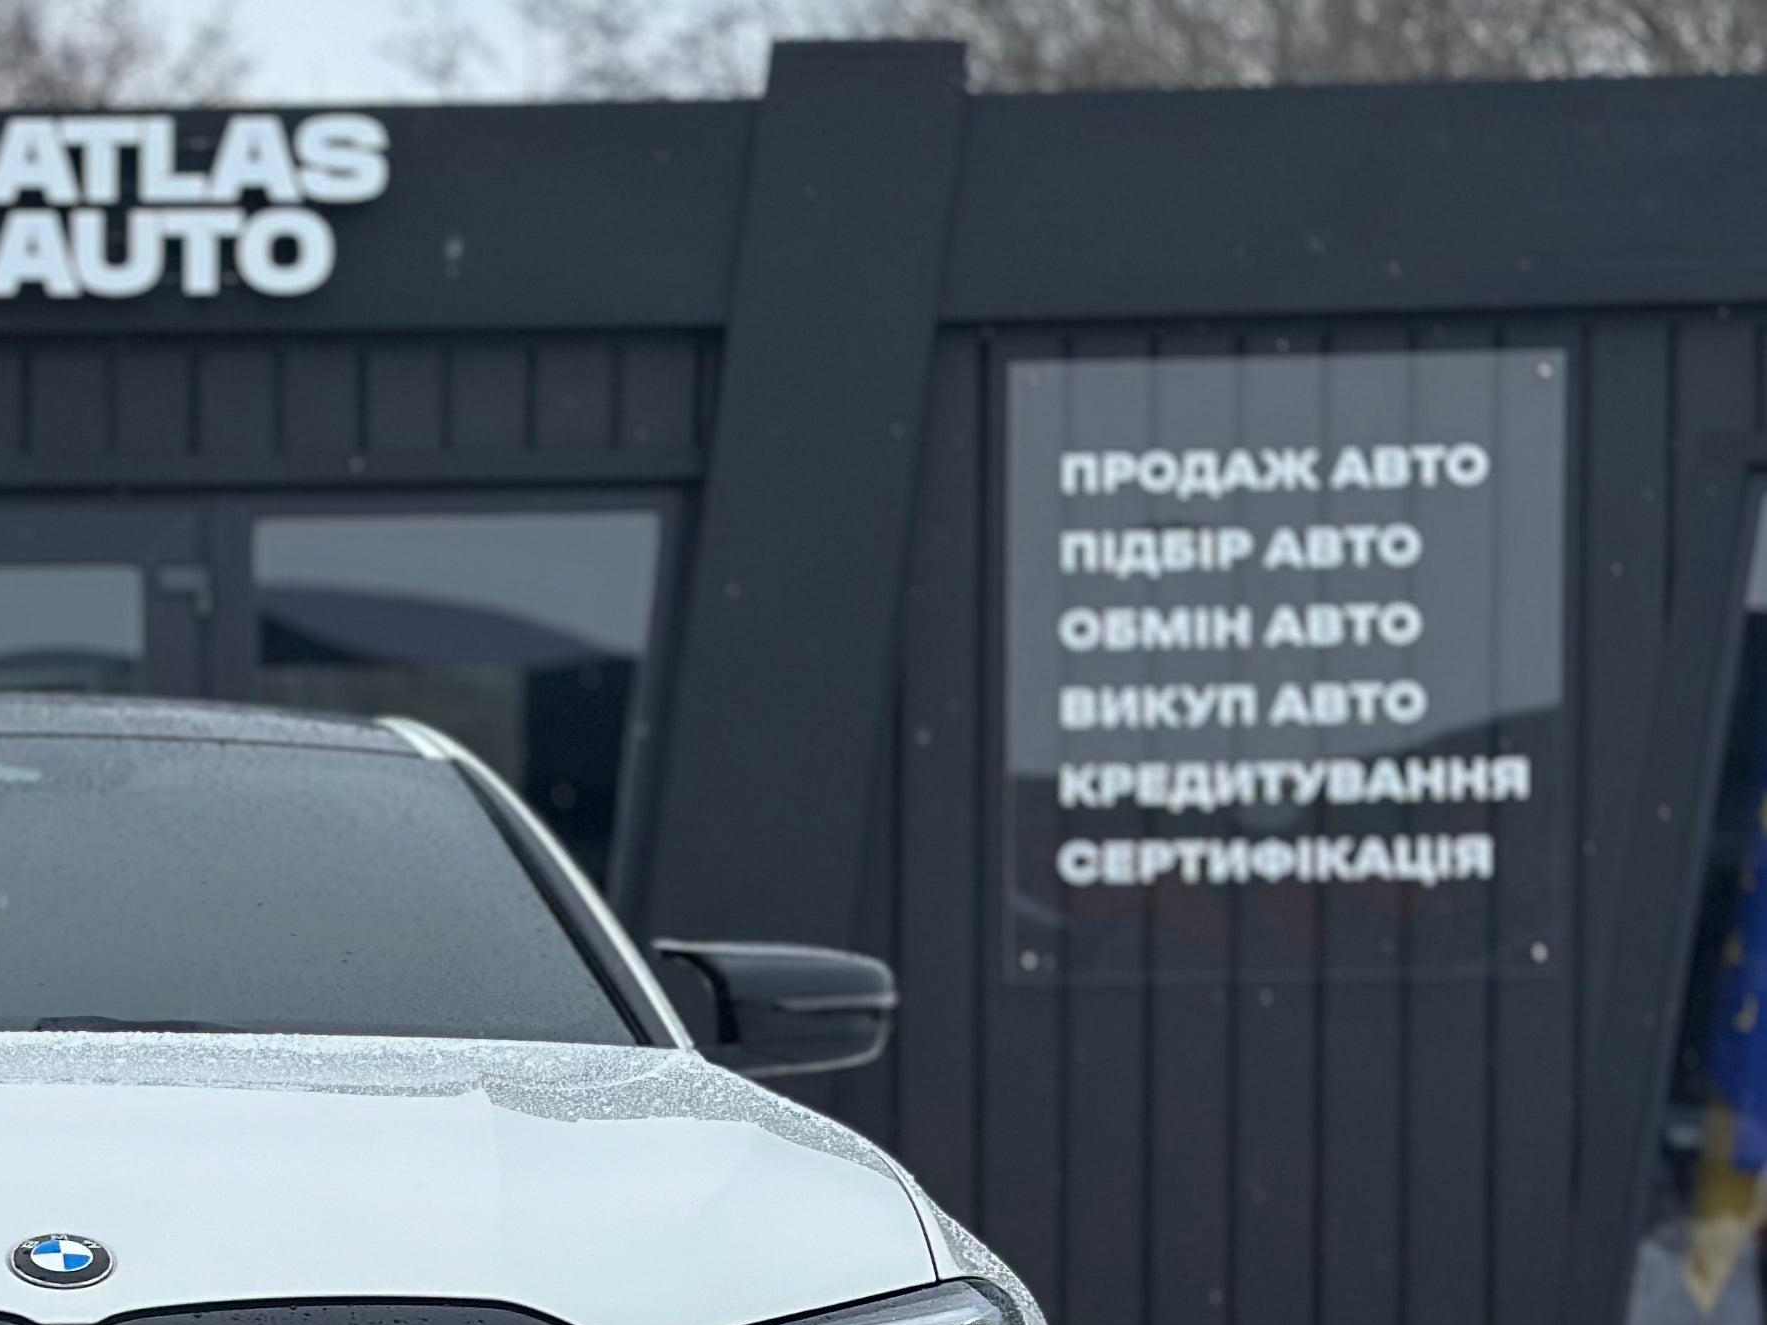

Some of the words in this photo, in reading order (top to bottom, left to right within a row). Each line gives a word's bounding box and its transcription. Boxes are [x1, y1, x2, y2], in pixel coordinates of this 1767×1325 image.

[1059, 447, 1320, 500] ПРОДАЖ
[1330, 441, 1491, 489] АВТО
[1059, 527, 1255, 579] ПІДБІР
[1262, 522, 1424, 570] АВТО
[1057, 606, 1254, 652] ОБМІН
[1262, 601, 1424, 647] АВТО
[1058, 683, 1259, 730] ВИКУП
[1268, 678, 1429, 725] АВТО
[1057, 754, 1532, 813] КРЕДИТУВАННЯ
[1056, 832, 1494, 887] СЕРТИФІКАЦІЯ
